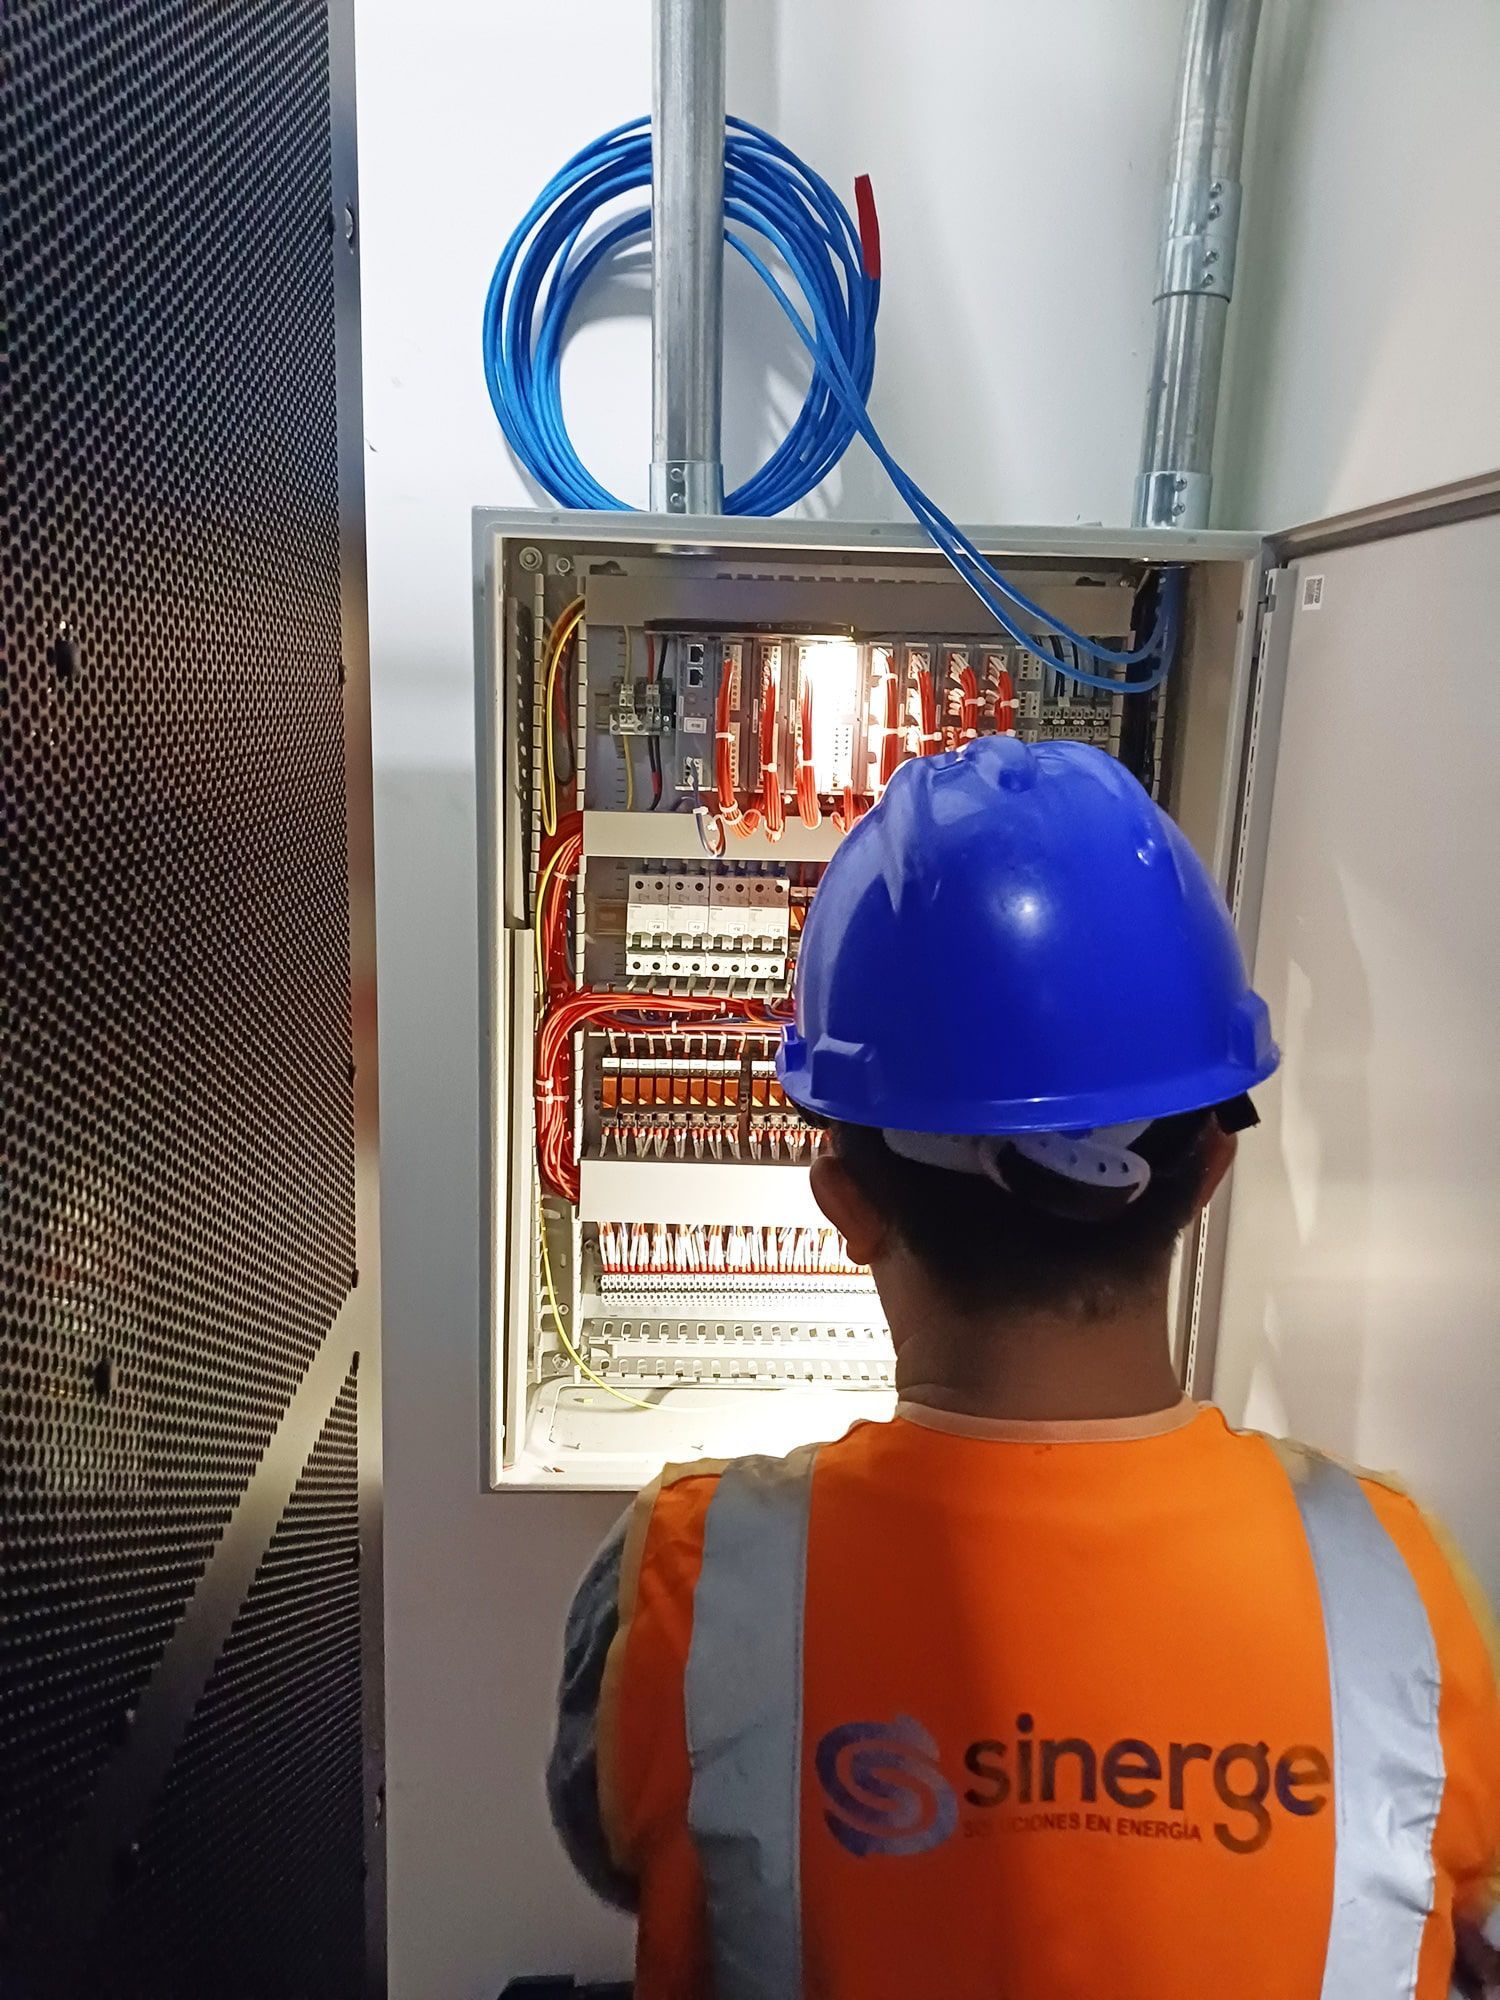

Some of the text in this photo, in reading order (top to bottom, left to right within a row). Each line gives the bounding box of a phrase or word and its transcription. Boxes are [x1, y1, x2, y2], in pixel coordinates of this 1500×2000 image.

[963, 1713, 1331, 1853] sinerge
[963, 1813, 1201, 1841] SOCIONES EN ENERGÍA
